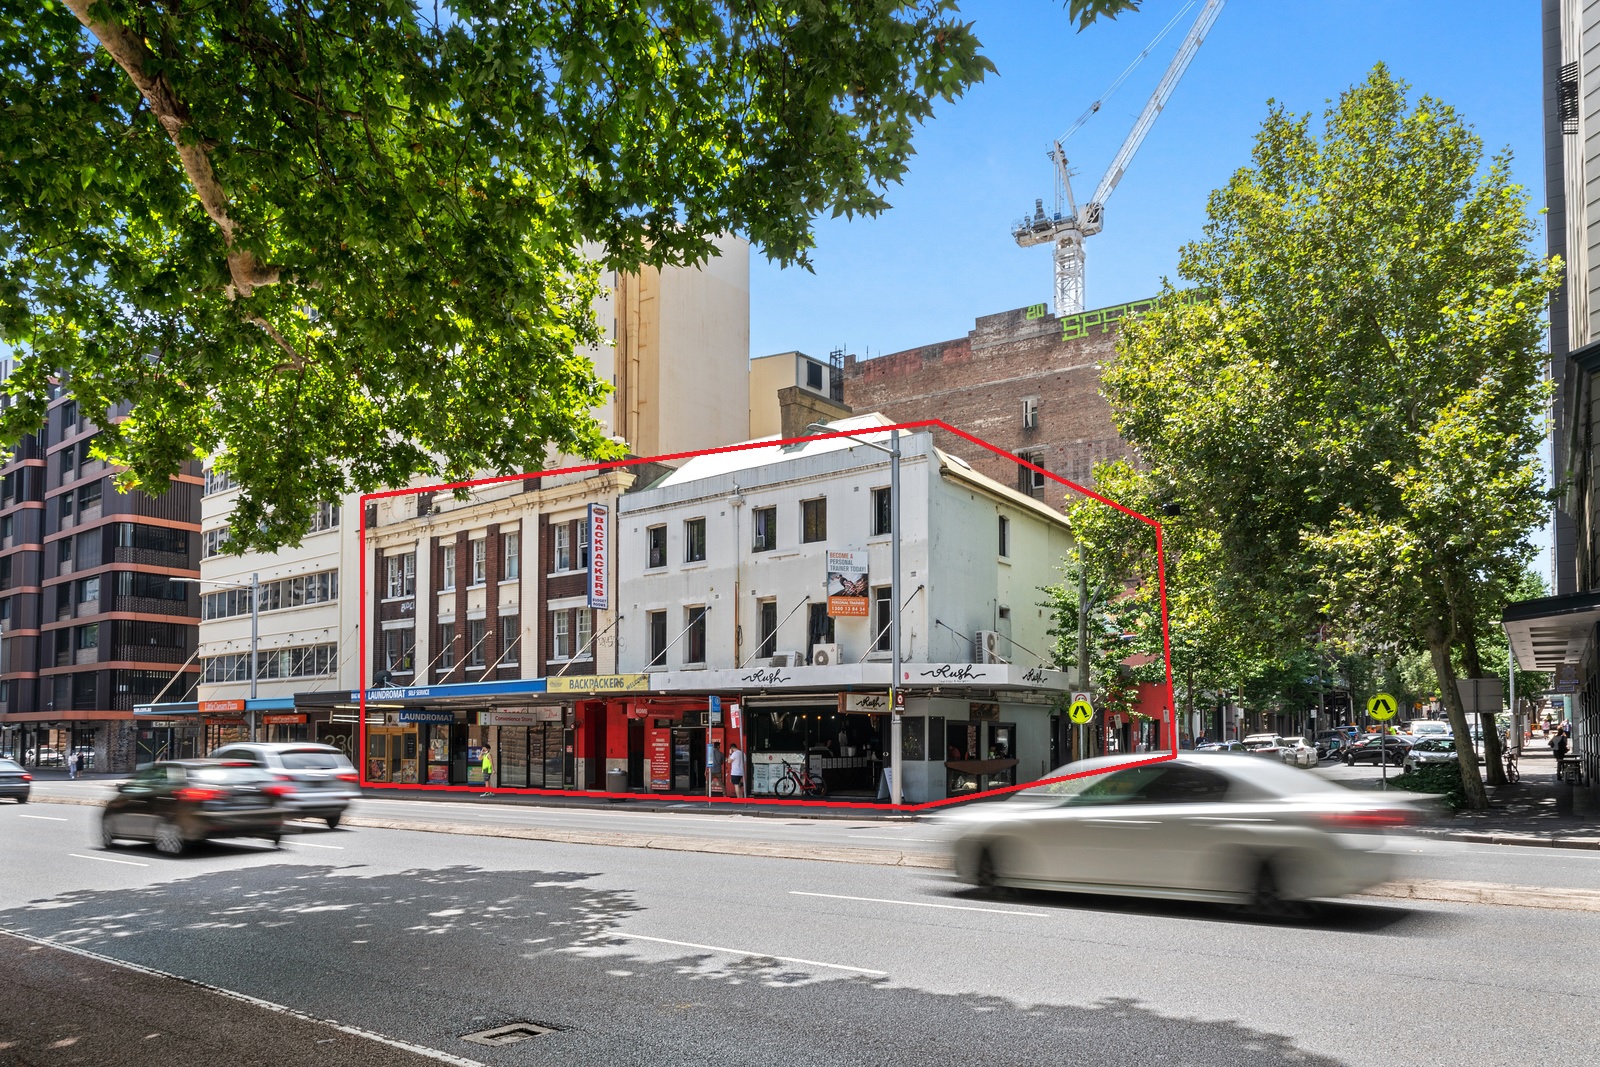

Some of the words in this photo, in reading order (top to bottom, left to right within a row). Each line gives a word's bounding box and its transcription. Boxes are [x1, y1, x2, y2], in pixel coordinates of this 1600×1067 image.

[594, 516, 604, 597] BACKPACKERS
[742, 668, 791, 684] Rush
[920, 664, 987, 680] Rush
[569, 677, 625, 689] BACKPACKERS
[367, 690, 405, 699] LAUNDROMAT
[400, 712, 453, 721] LAUNDROMAT
